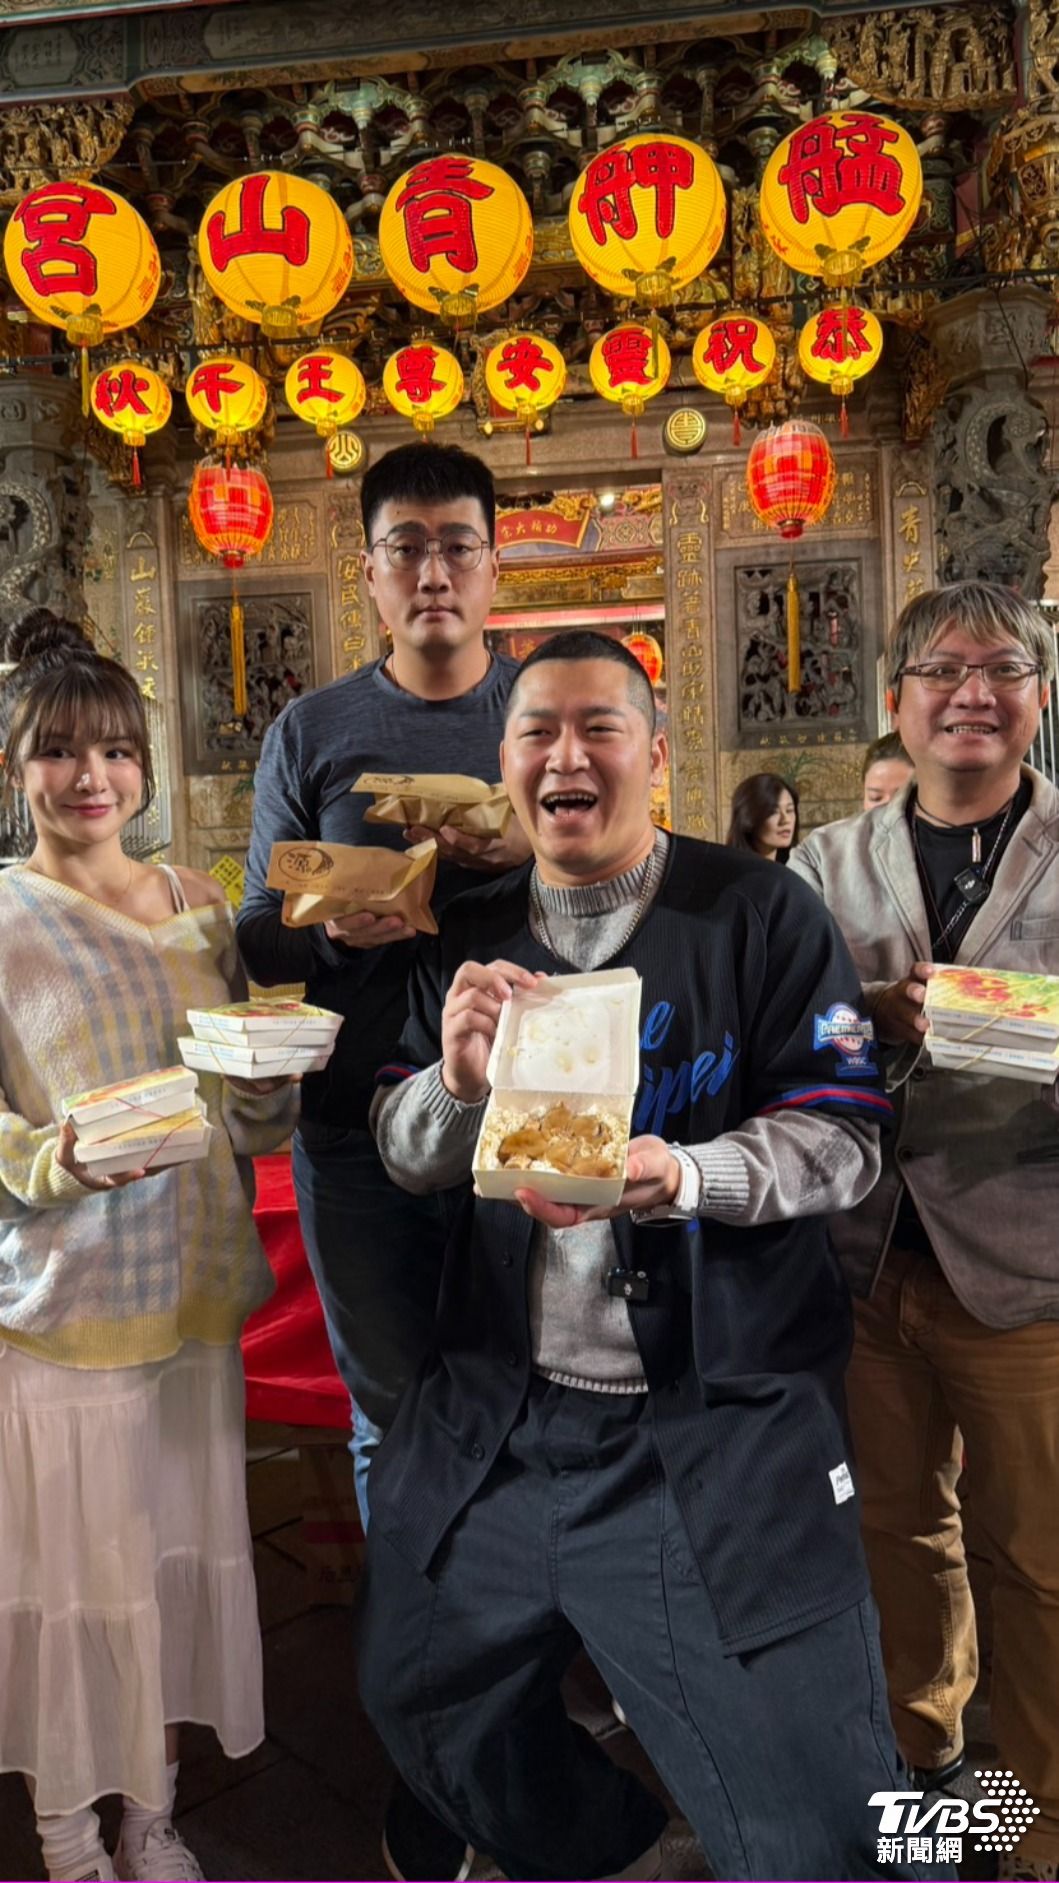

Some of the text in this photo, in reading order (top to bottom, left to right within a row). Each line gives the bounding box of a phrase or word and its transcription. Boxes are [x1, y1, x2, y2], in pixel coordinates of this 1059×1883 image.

[577, 141, 695, 246] 舺
[778, 112, 906, 224] 艋
[13, 180, 117, 297] 宮
[206, 174, 311, 273] 山
[395, 156, 495, 274] 青
[703, 319, 765, 374] 祝
[811, 306, 872, 363] 恭
[95, 369, 151, 417] 秋
[191, 363, 245, 413] 千
[297, 356, 345, 403] 王
[396, 345, 446, 403] 尊
[497, 337, 554, 391] 安
[634, 1030, 741, 1138] ipei
